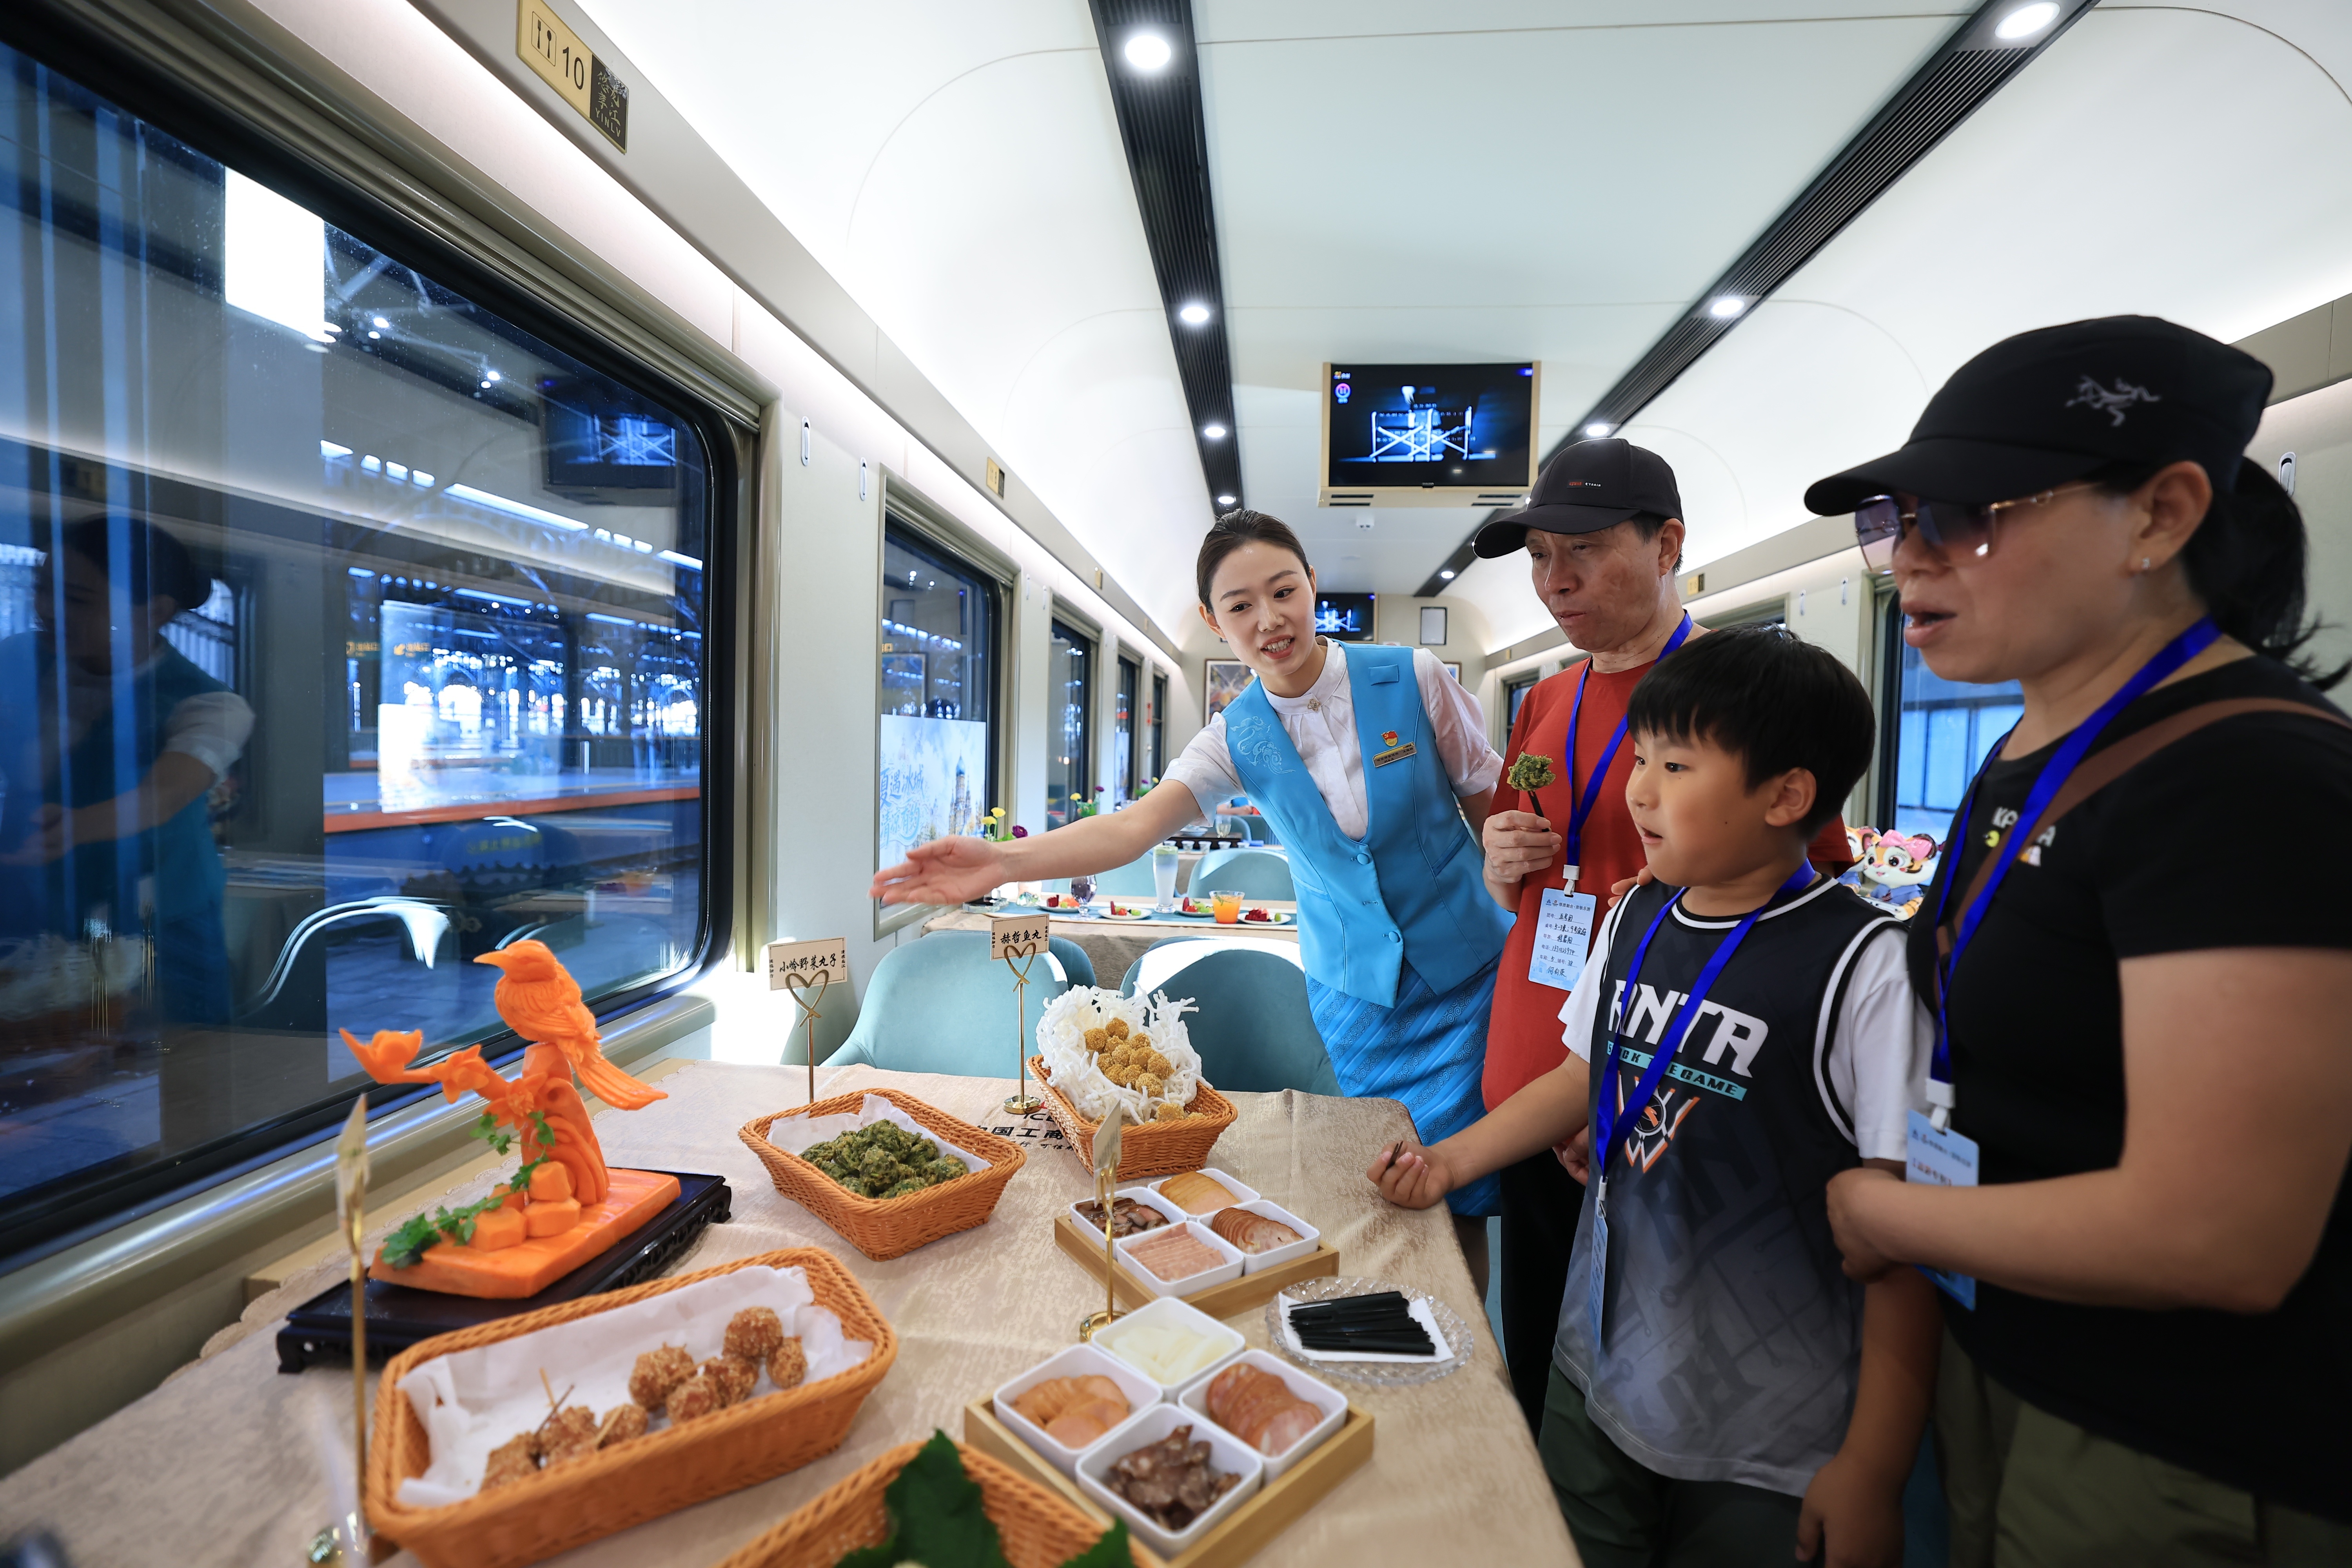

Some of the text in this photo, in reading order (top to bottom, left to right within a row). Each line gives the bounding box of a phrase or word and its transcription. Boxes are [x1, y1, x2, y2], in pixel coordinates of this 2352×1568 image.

[563, 47, 584, 90] 10
[595, 107, 621, 137] YINLV
[880, 764, 924, 811] 夏遇冰城
[1000, 929, 1042, 945] 赫哲鱼丸
[779, 953, 836, 973] 小岭野菜丸子
[1608, 1043, 1738, 1095] SCK GAME
[977, 1125, 1064, 1140] 国工商
